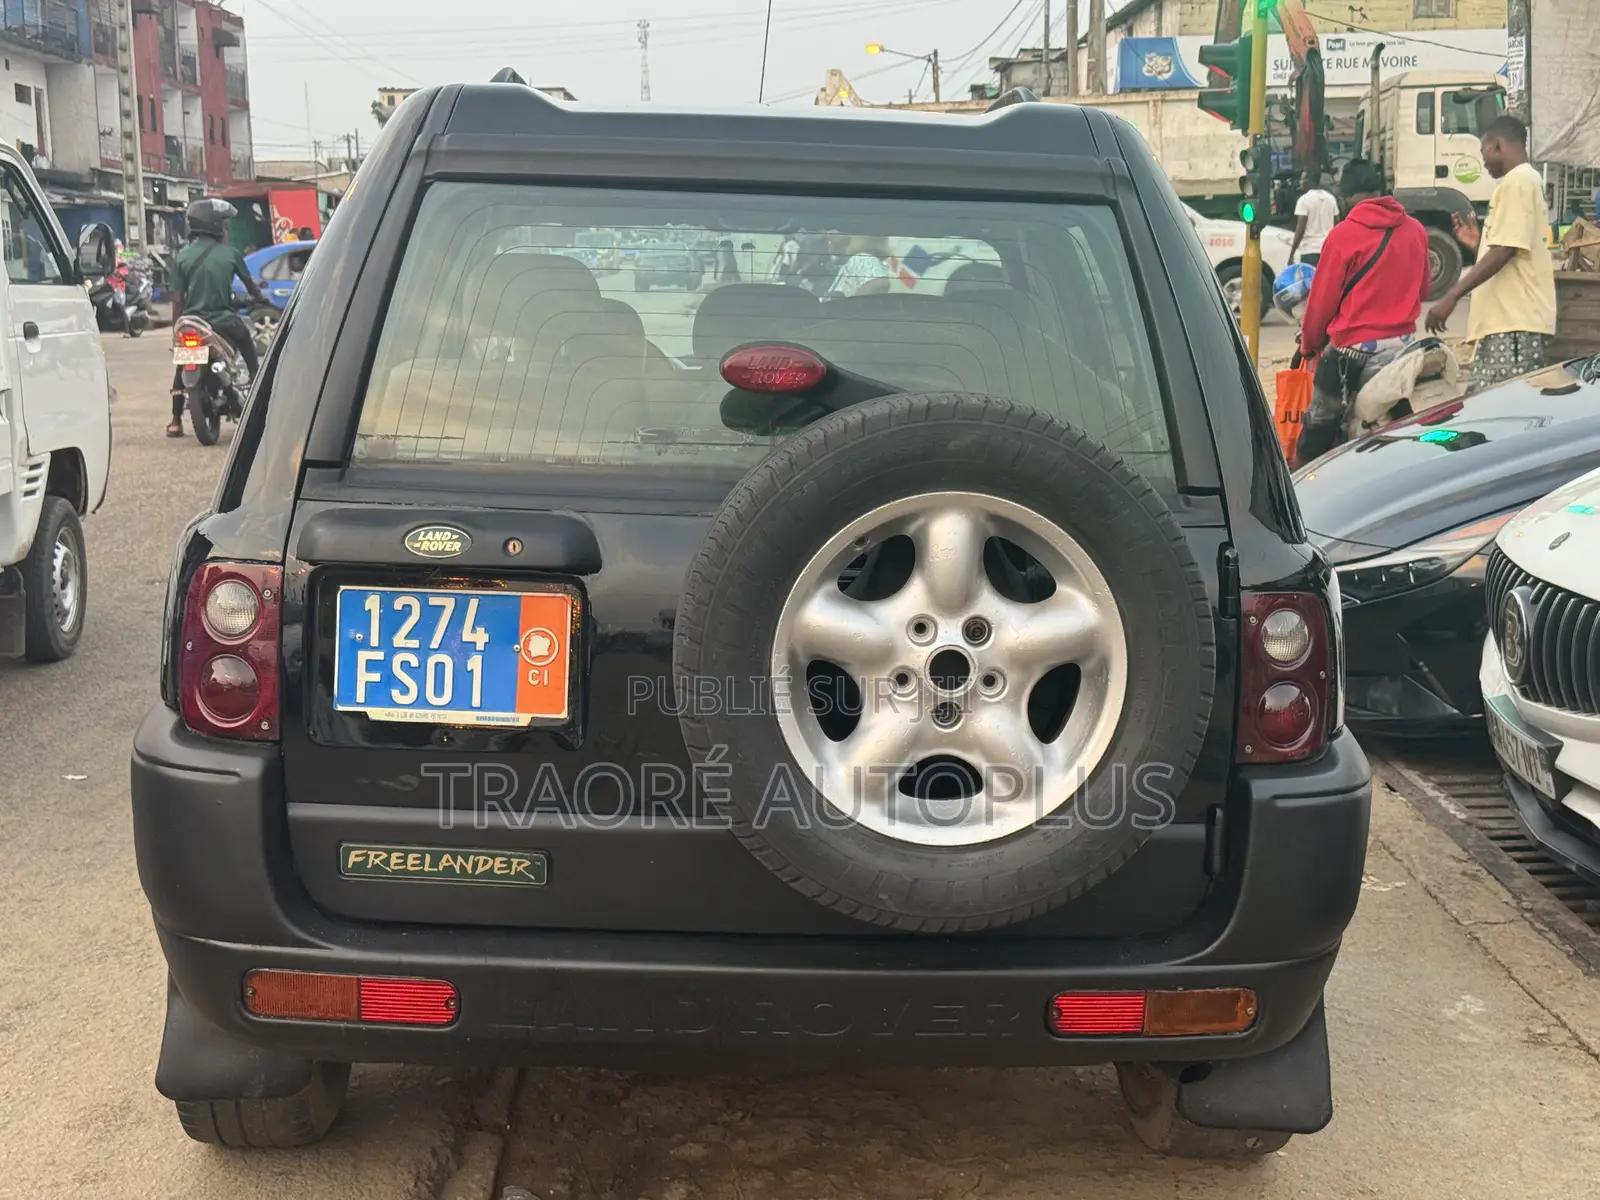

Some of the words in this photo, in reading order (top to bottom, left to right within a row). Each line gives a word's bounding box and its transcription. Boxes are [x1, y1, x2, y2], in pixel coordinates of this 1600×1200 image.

[1335, 57, 1359, 69] RUE
[748, 356, 793, 370] LAND
[751, 371, 807, 384] ROVER
[418, 531, 452, 541] LAND
[420, 541, 462, 552] ROVER
[364, 594, 489, 651] 1274
[355, 650, 483, 708] FS01
[528, 669, 549, 686] CI
[347, 849, 536, 880] FREELANDER
